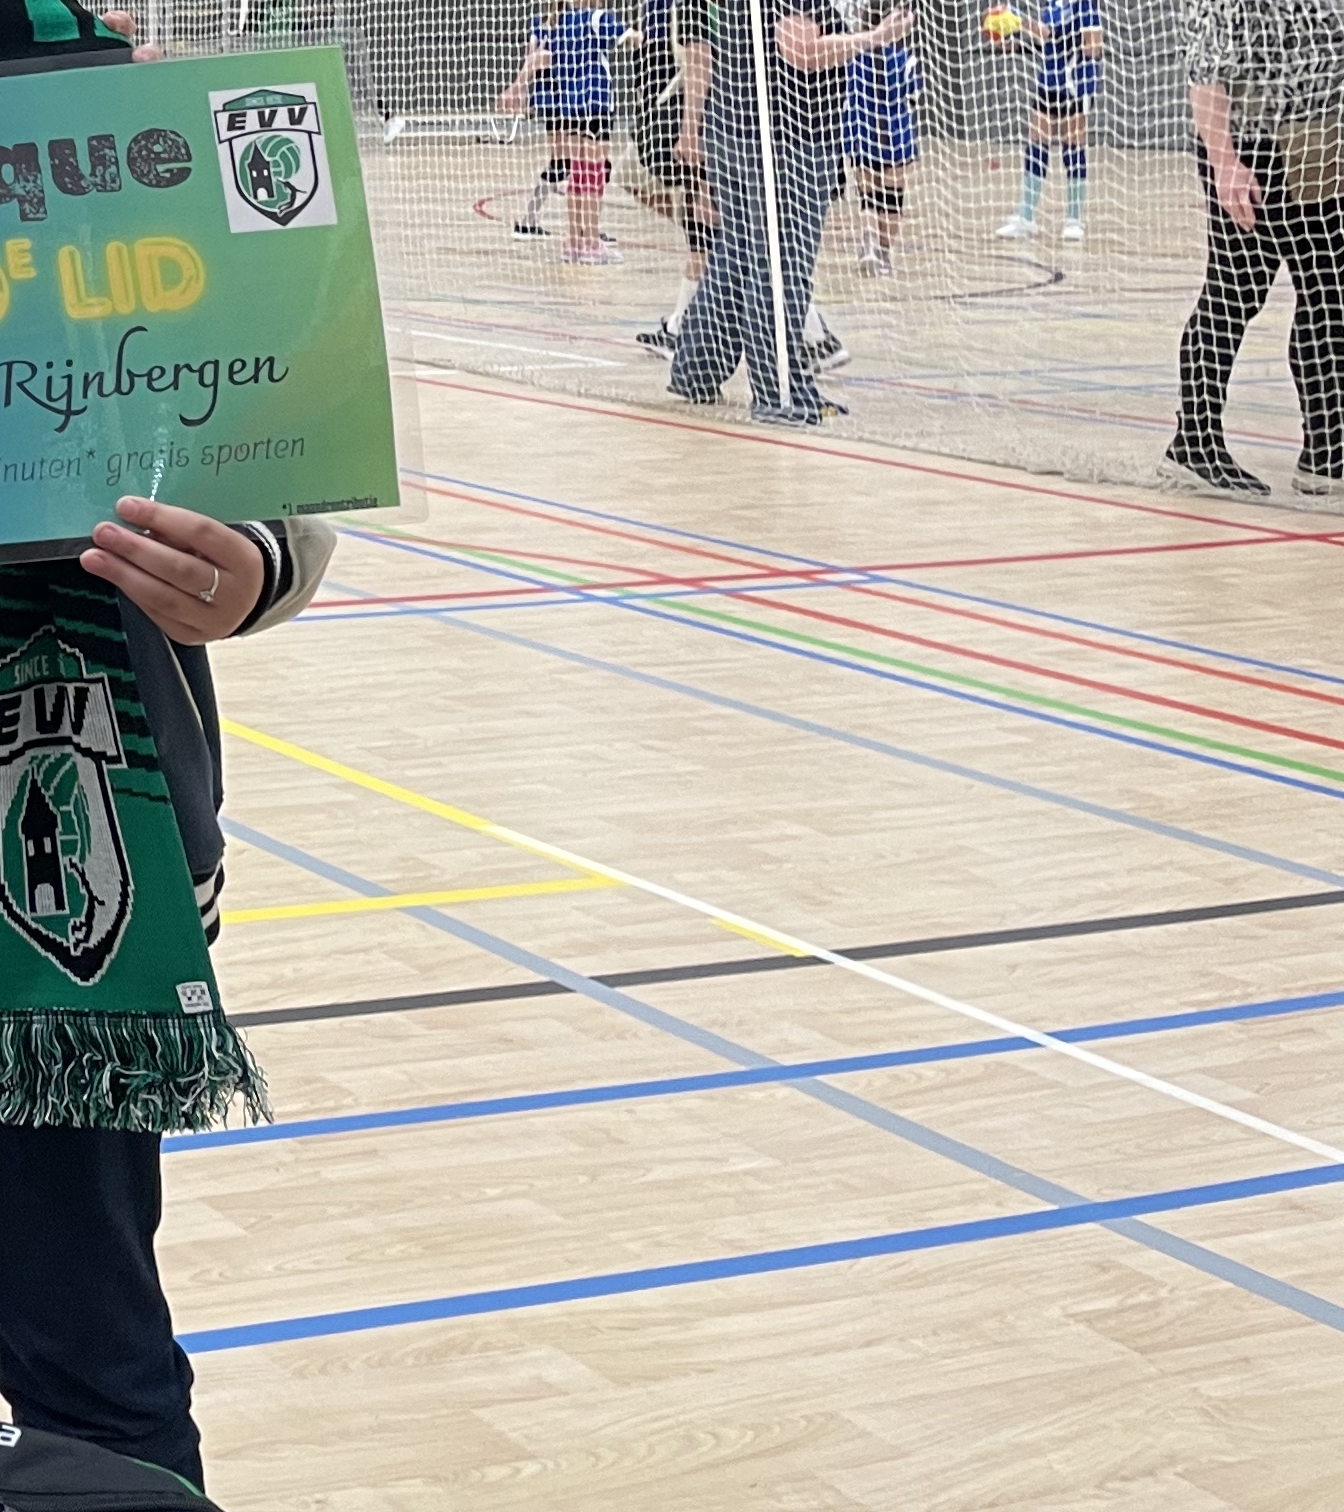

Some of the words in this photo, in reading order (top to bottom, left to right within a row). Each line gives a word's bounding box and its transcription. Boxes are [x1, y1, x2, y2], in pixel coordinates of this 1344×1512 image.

[226, 105, 308, 132] EVV
[58, 236, 205, 319] LID
[200, 434, 306, 477] sporten
[14, 654, 50, 685] SINCE
